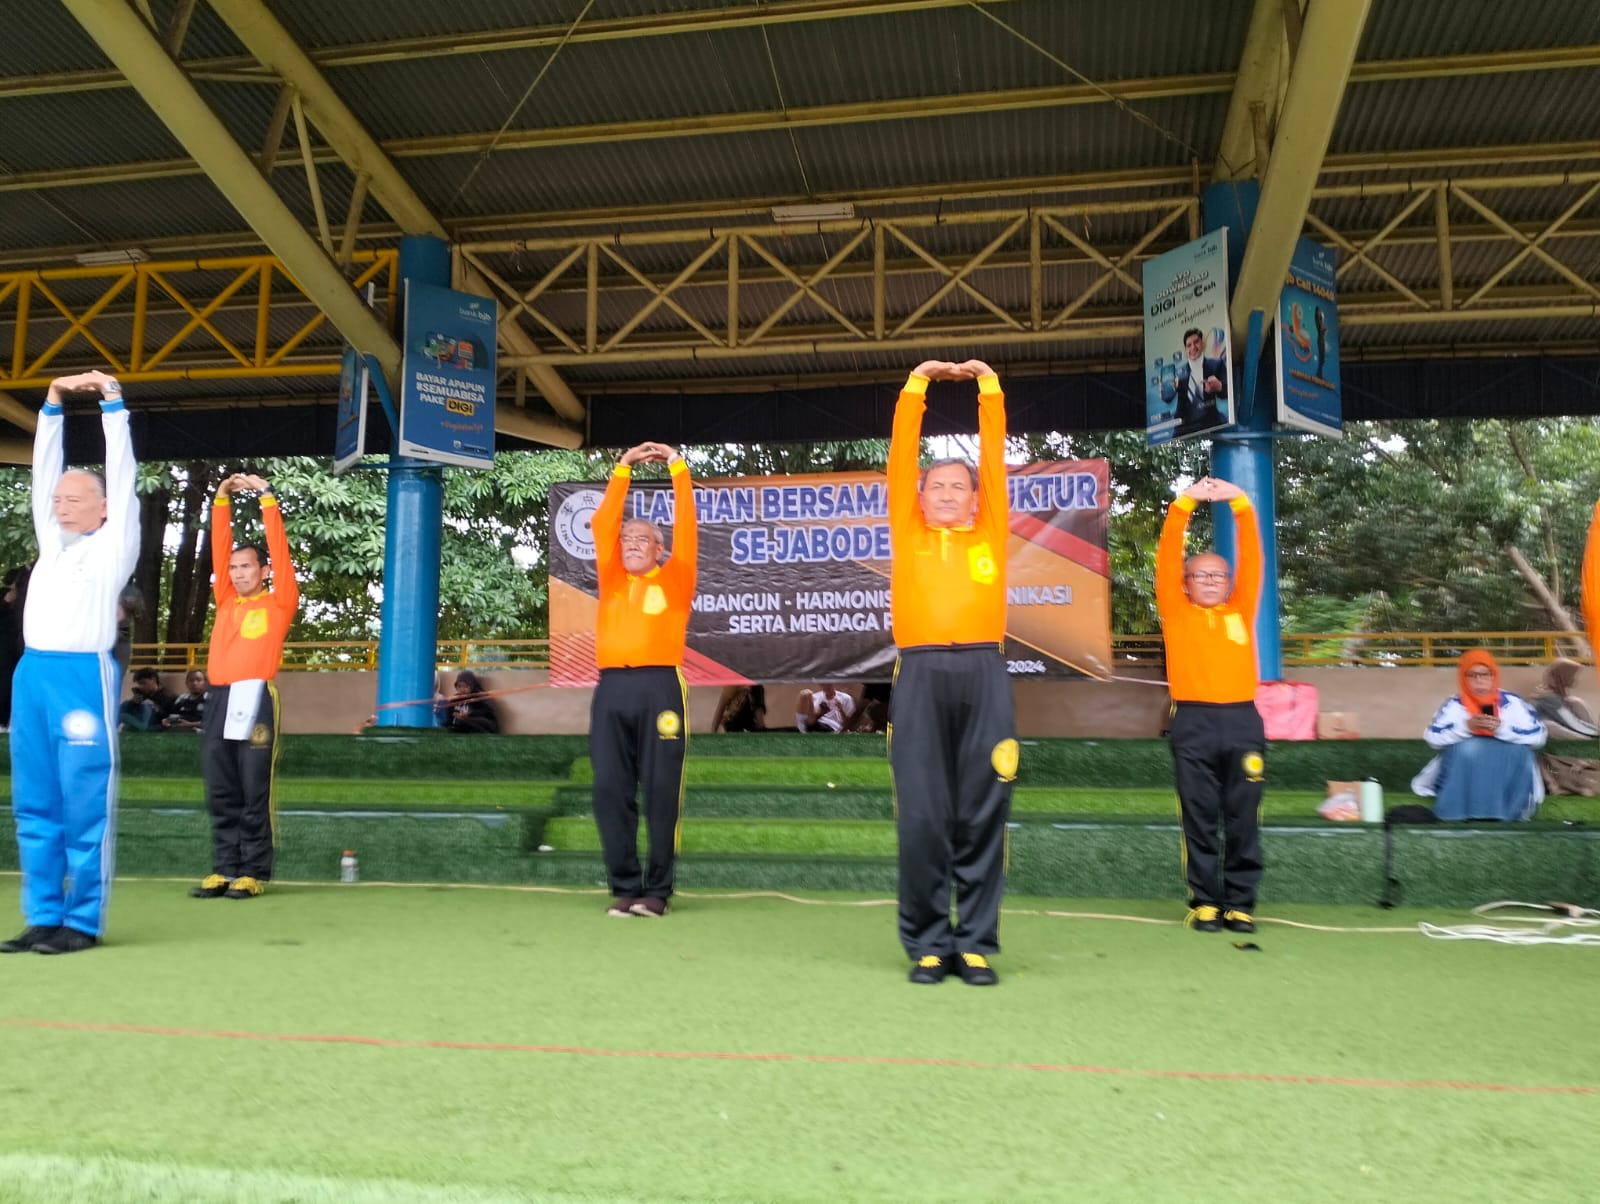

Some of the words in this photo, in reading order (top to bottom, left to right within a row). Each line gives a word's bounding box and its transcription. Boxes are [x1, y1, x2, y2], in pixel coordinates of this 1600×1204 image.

[1150, 296, 1176, 317] DIGI
[415, 371, 447, 386] BAYAR
[448, 377, 486, 393] APAPUN
[419, 393, 446, 406] PAKE
[448, 399, 474, 414] DIGI
[633, 487, 755, 525] LAHAN
[730, 523, 892, 565] SE-JABODE
[691, 592, 781, 613] MBANGUN
[796, 589, 892, 611] HARMONIS
[1006, 585, 1073, 606] NIKASI
[729, 614, 787, 634] SERTA
[790, 612, 880, 633] MENJAGA
[1006, 659, 1047, 674] 2024
